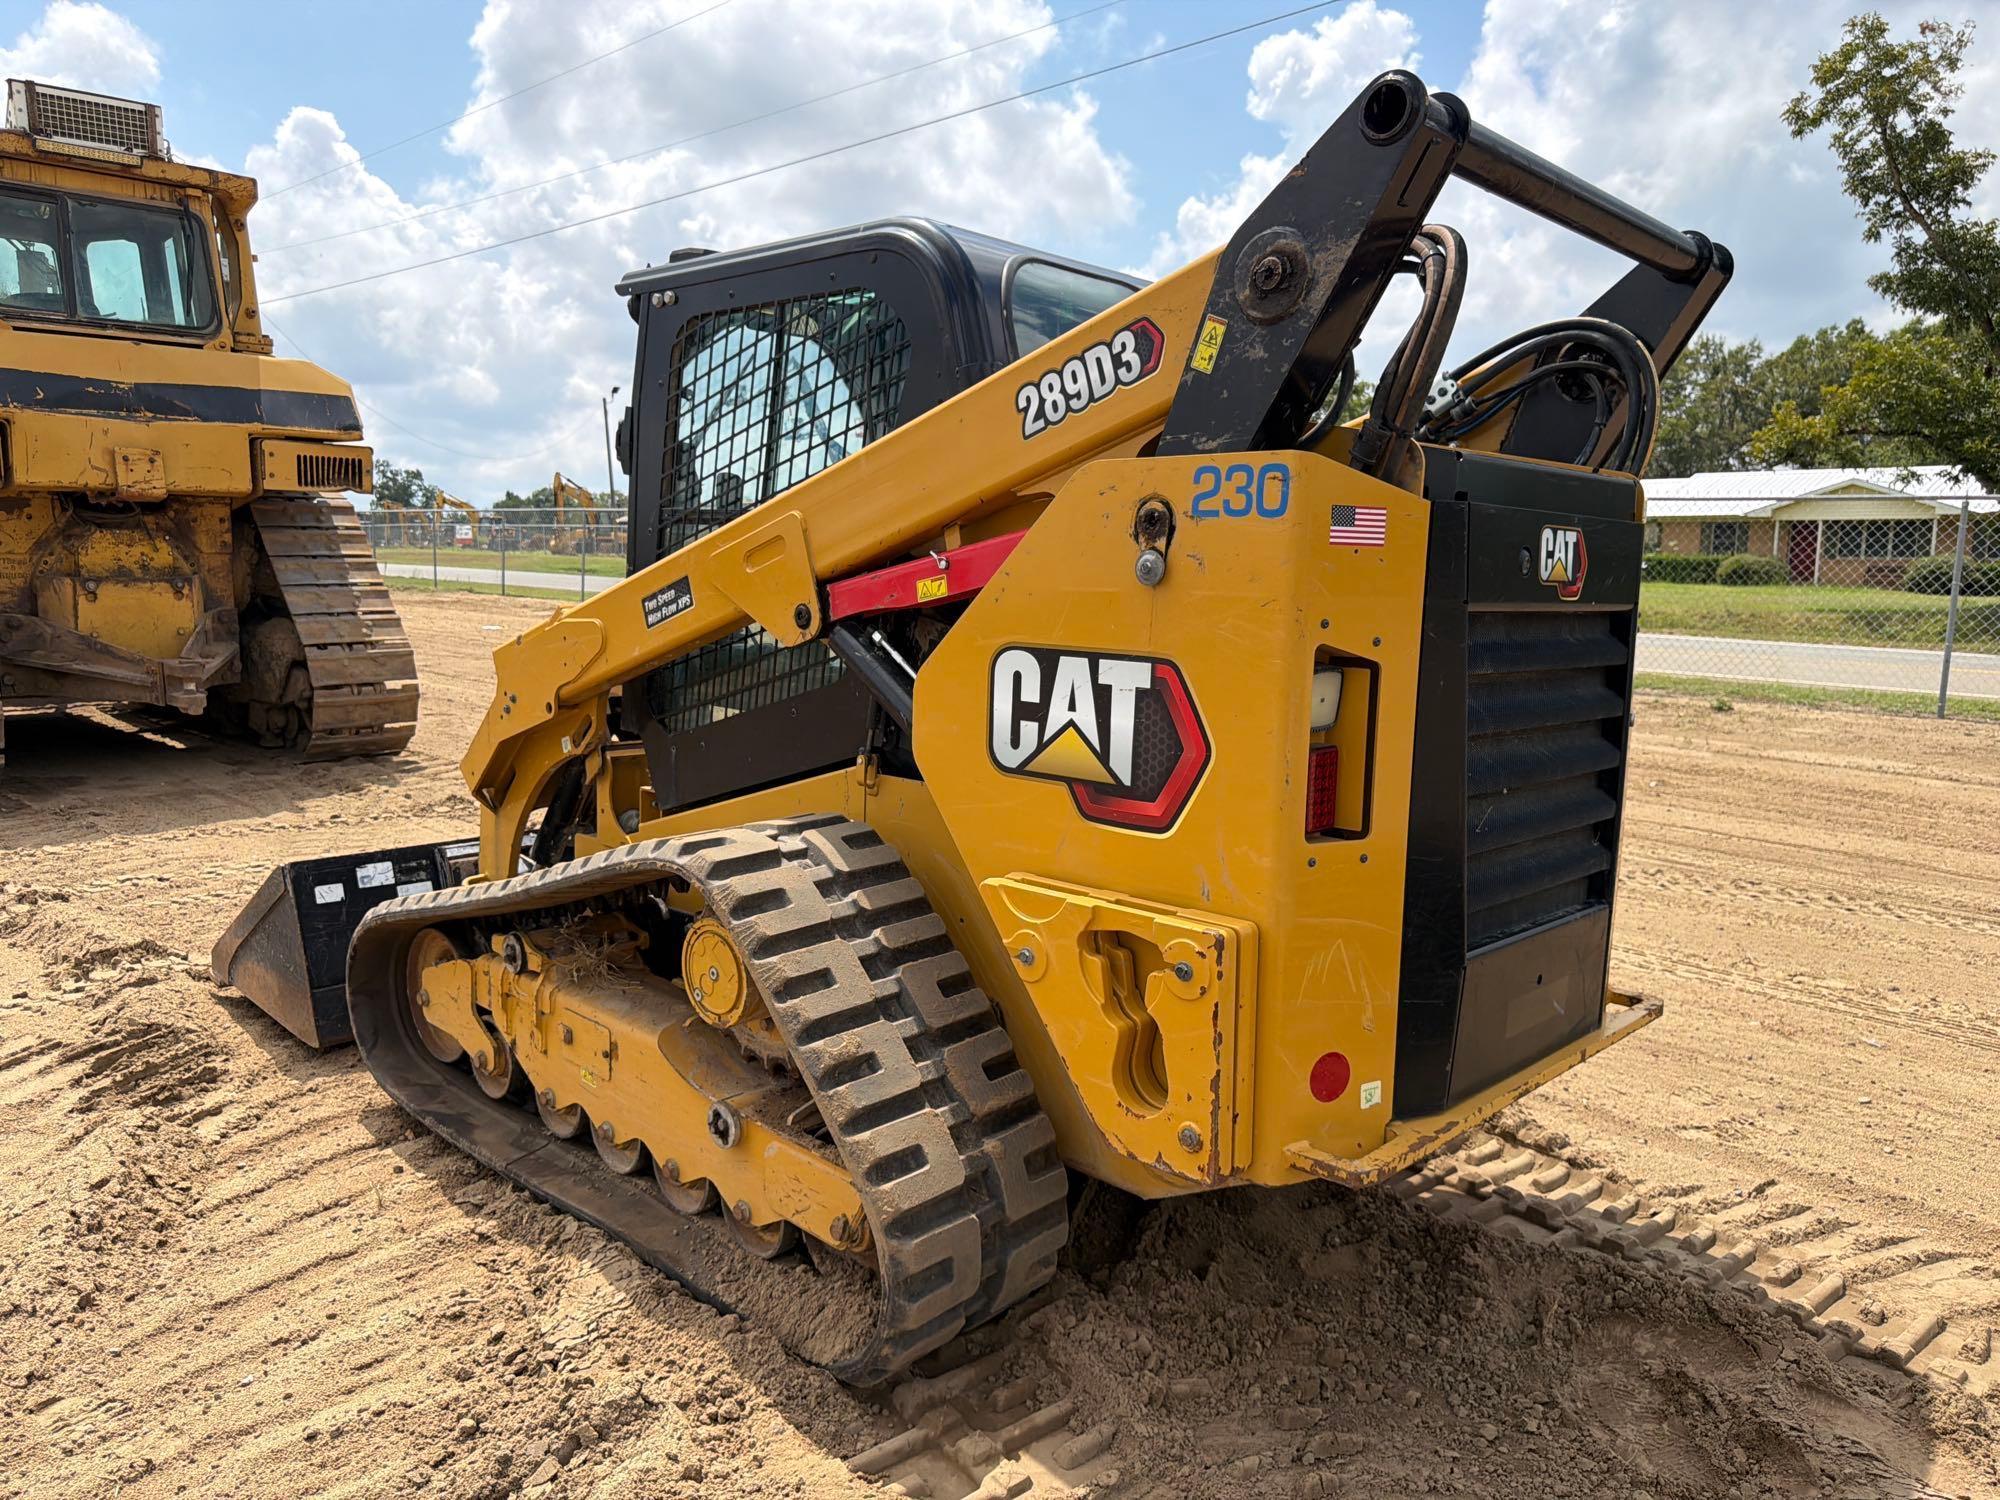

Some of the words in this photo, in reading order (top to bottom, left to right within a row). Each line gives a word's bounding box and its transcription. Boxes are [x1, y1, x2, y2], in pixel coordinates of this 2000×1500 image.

[1017, 330, 1142, 437] 289D3
[1191, 463, 1290, 518] 230
[1541, 528, 1578, 581] CAT
[677, 594, 691, 610] XPS
[993, 650, 1152, 787] CAT
